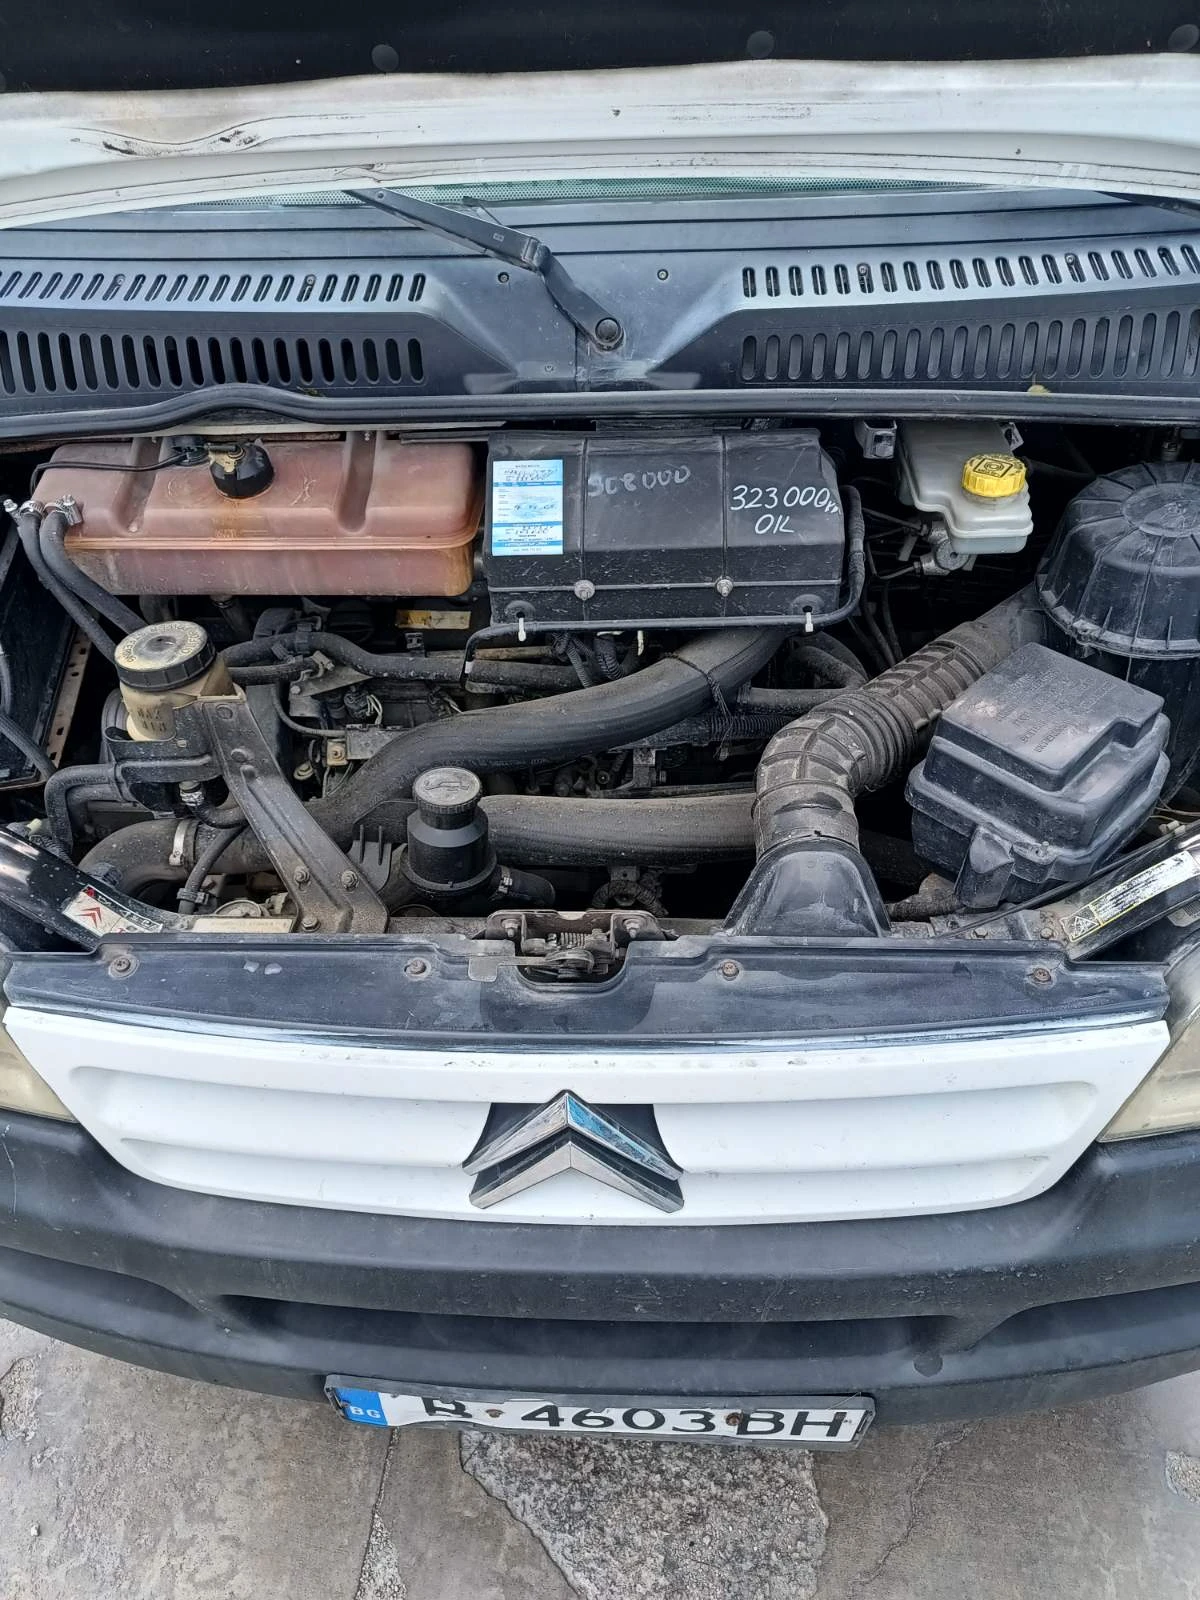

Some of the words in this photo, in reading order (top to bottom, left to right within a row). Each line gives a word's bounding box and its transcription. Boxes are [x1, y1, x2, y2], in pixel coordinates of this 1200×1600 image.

[351, 1405, 381, 1419] BG
[520, 1404, 716, 1433] 4603
[736, 1409, 848, 1438] BH
